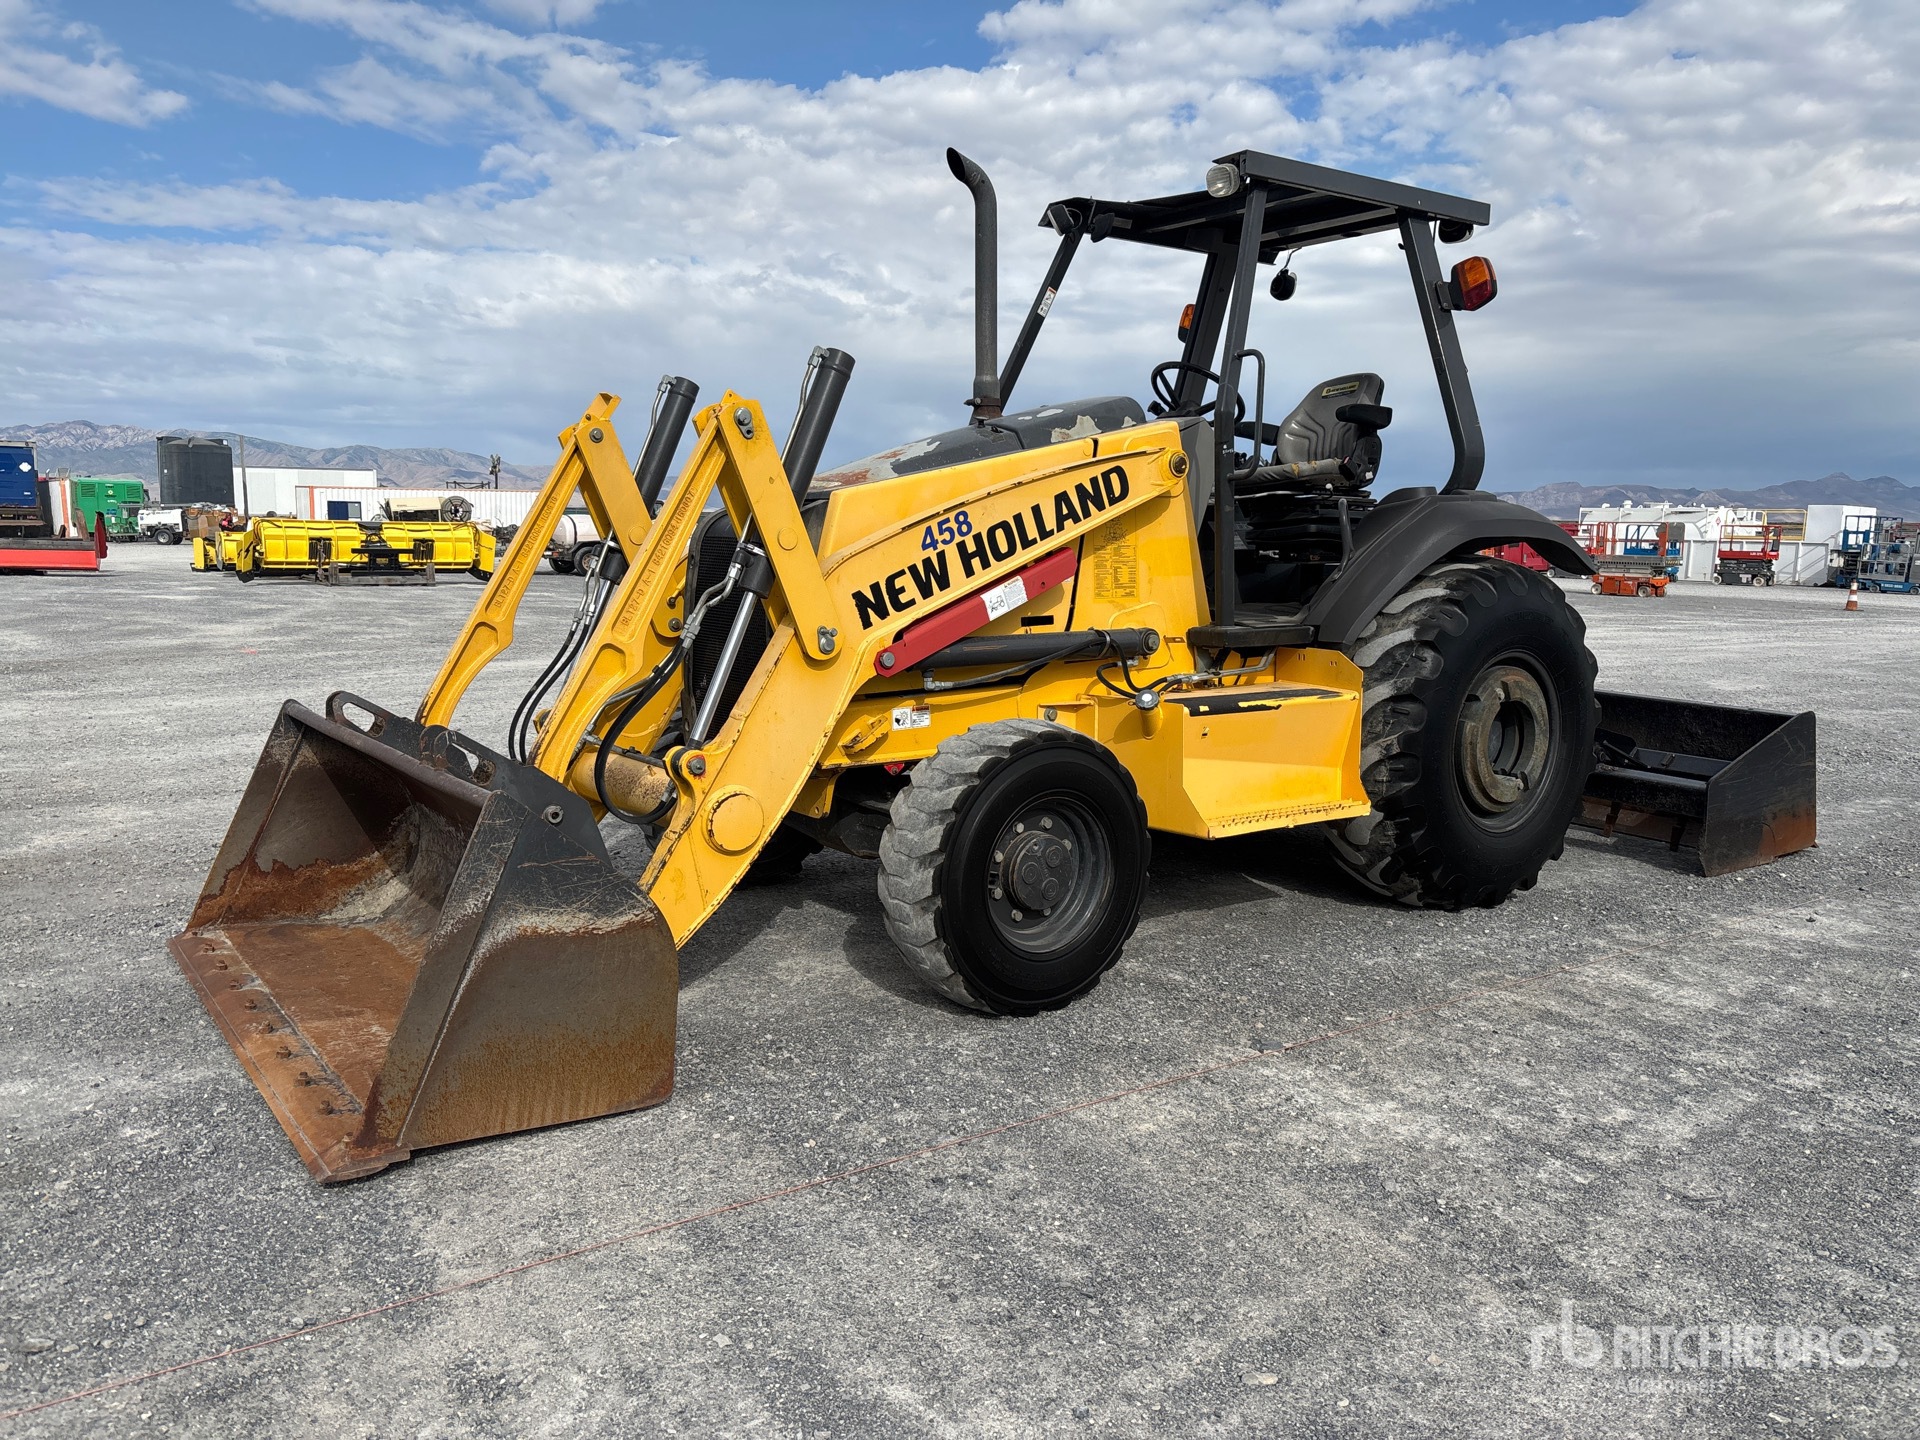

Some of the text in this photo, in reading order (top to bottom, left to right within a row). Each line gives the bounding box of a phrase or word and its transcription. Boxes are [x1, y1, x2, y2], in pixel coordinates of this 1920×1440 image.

[852, 549, 951, 630] NEW
[956, 465, 1130, 579] HOLLAND
[921, 510, 973, 551] 458
